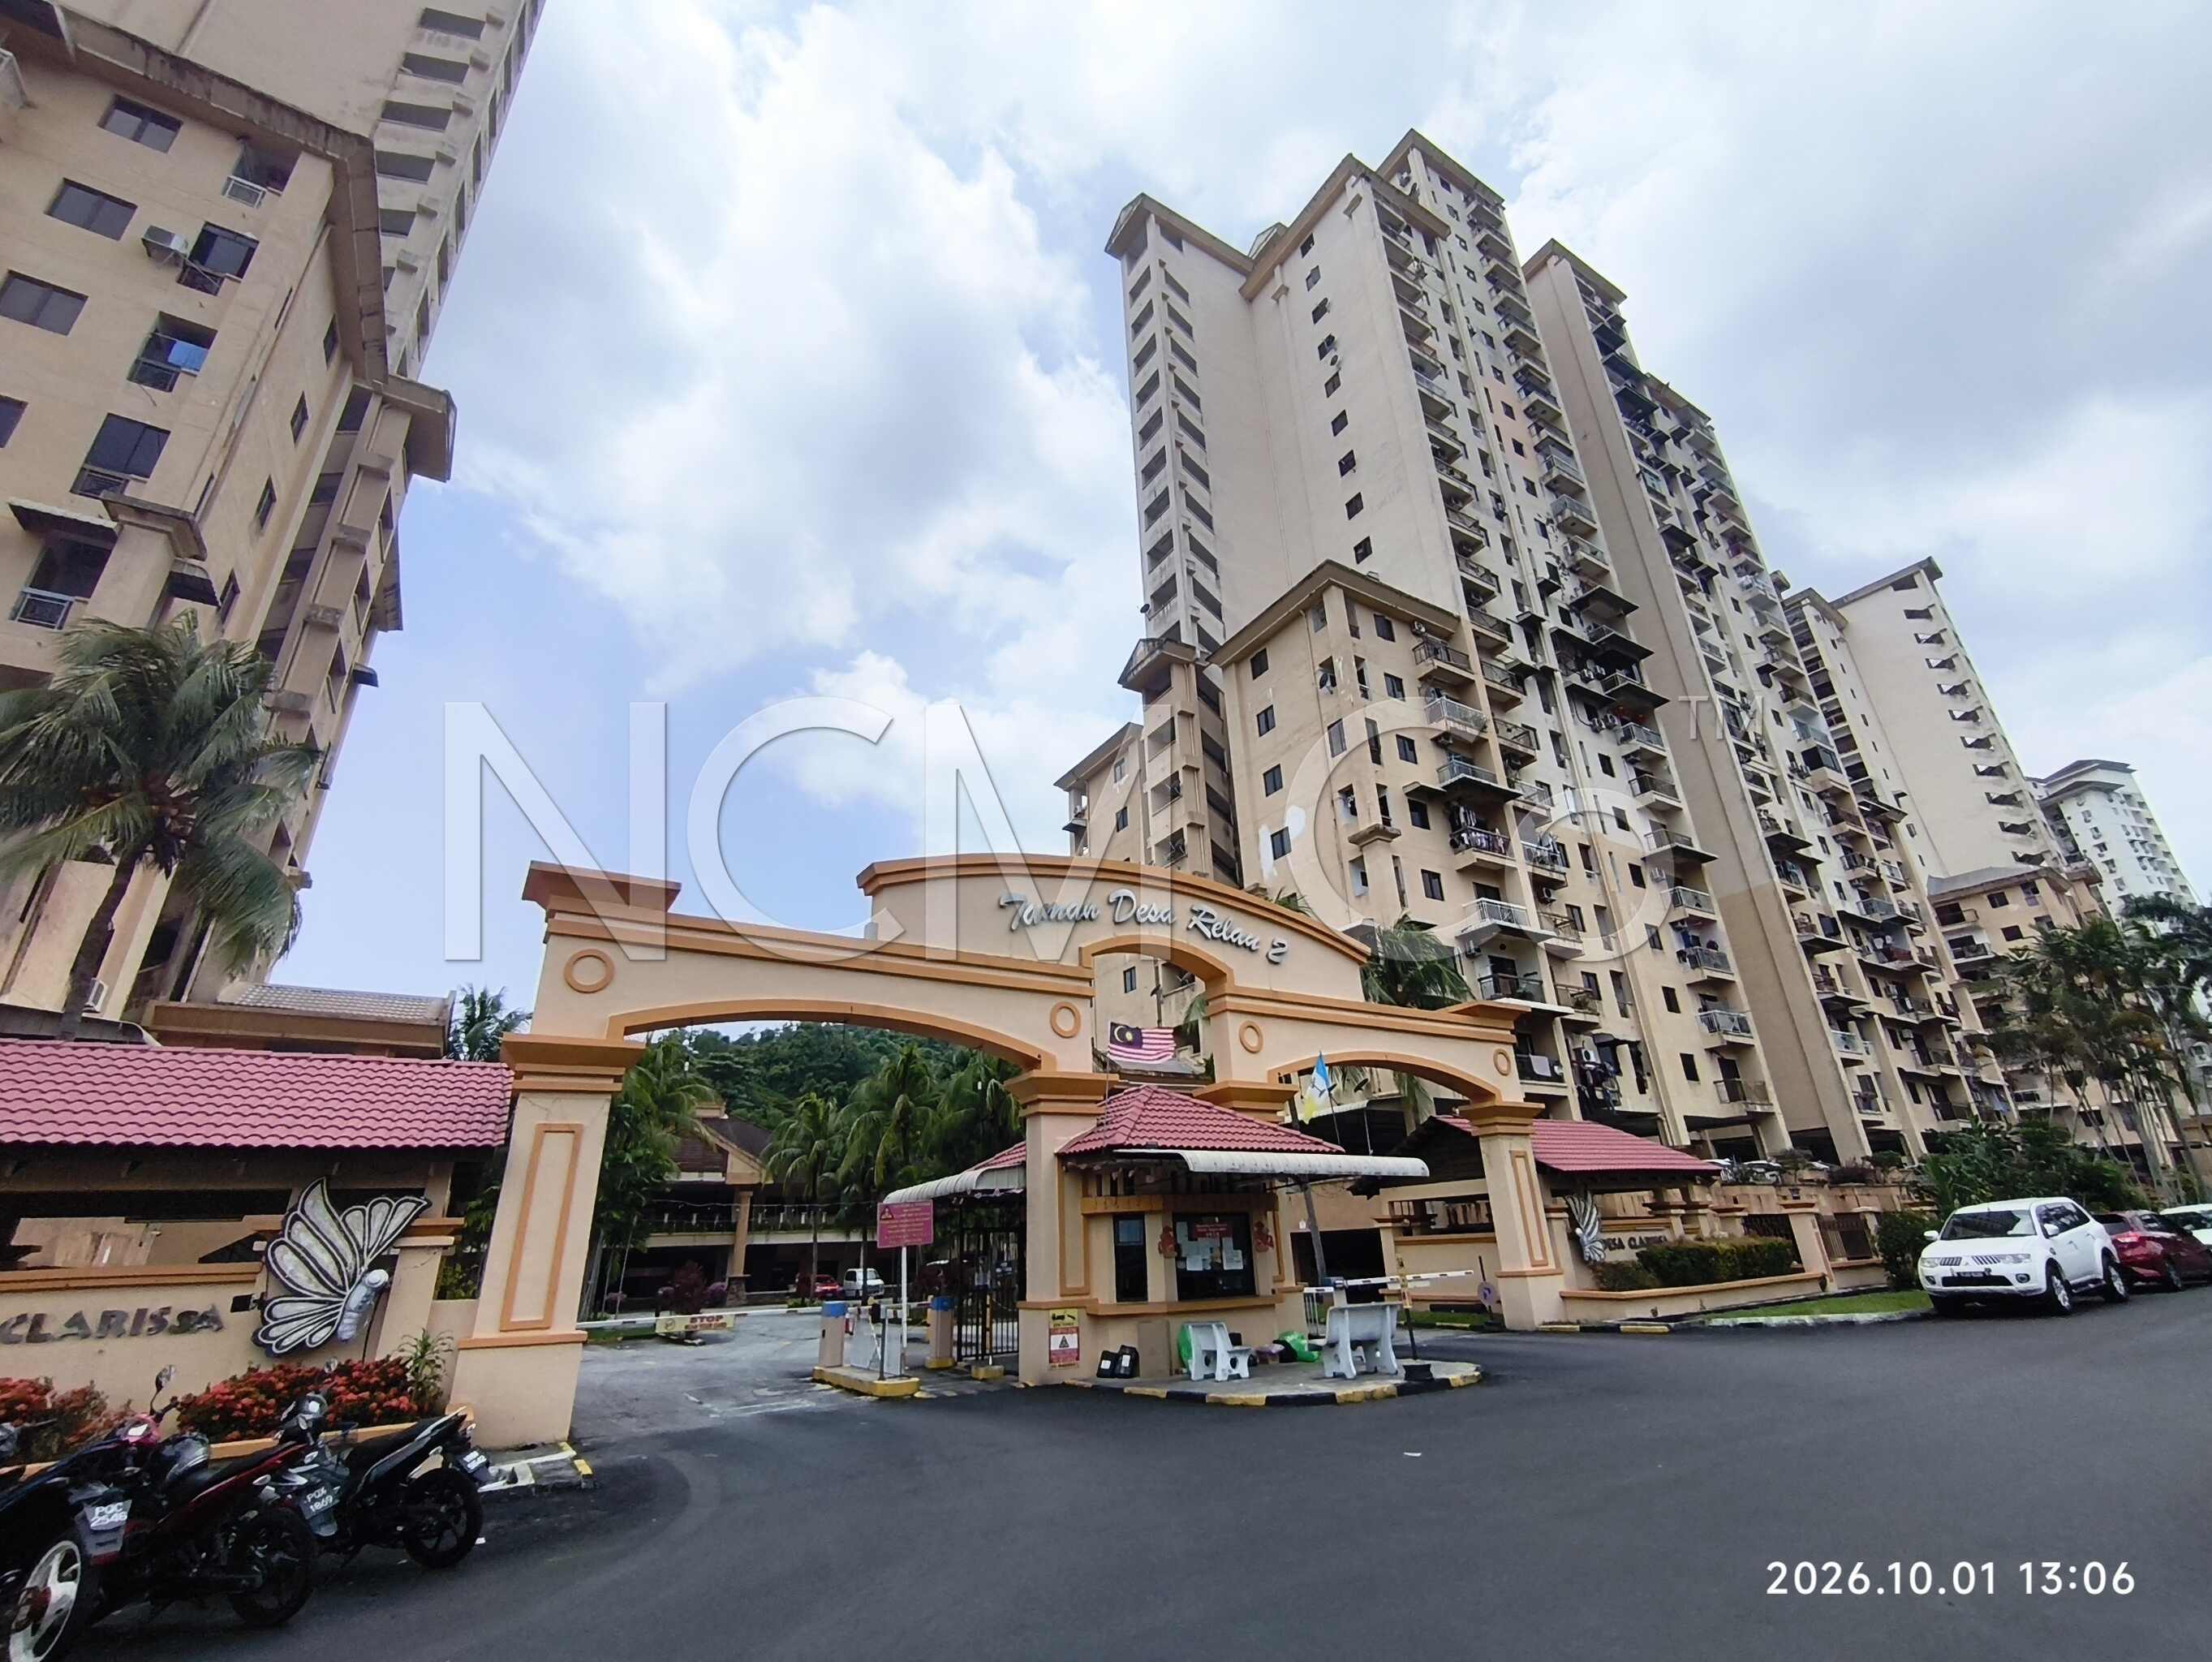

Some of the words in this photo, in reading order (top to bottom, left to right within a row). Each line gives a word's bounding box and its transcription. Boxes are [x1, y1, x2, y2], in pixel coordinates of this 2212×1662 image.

[999, 894, 1100, 932] Taman
[1108, 888, 1177, 926] Desa
[1265, 936, 1290, 967] 2
[0, 1304, 225, 1345] CLARISSA
[690, 1315, 724, 1324] STOP
